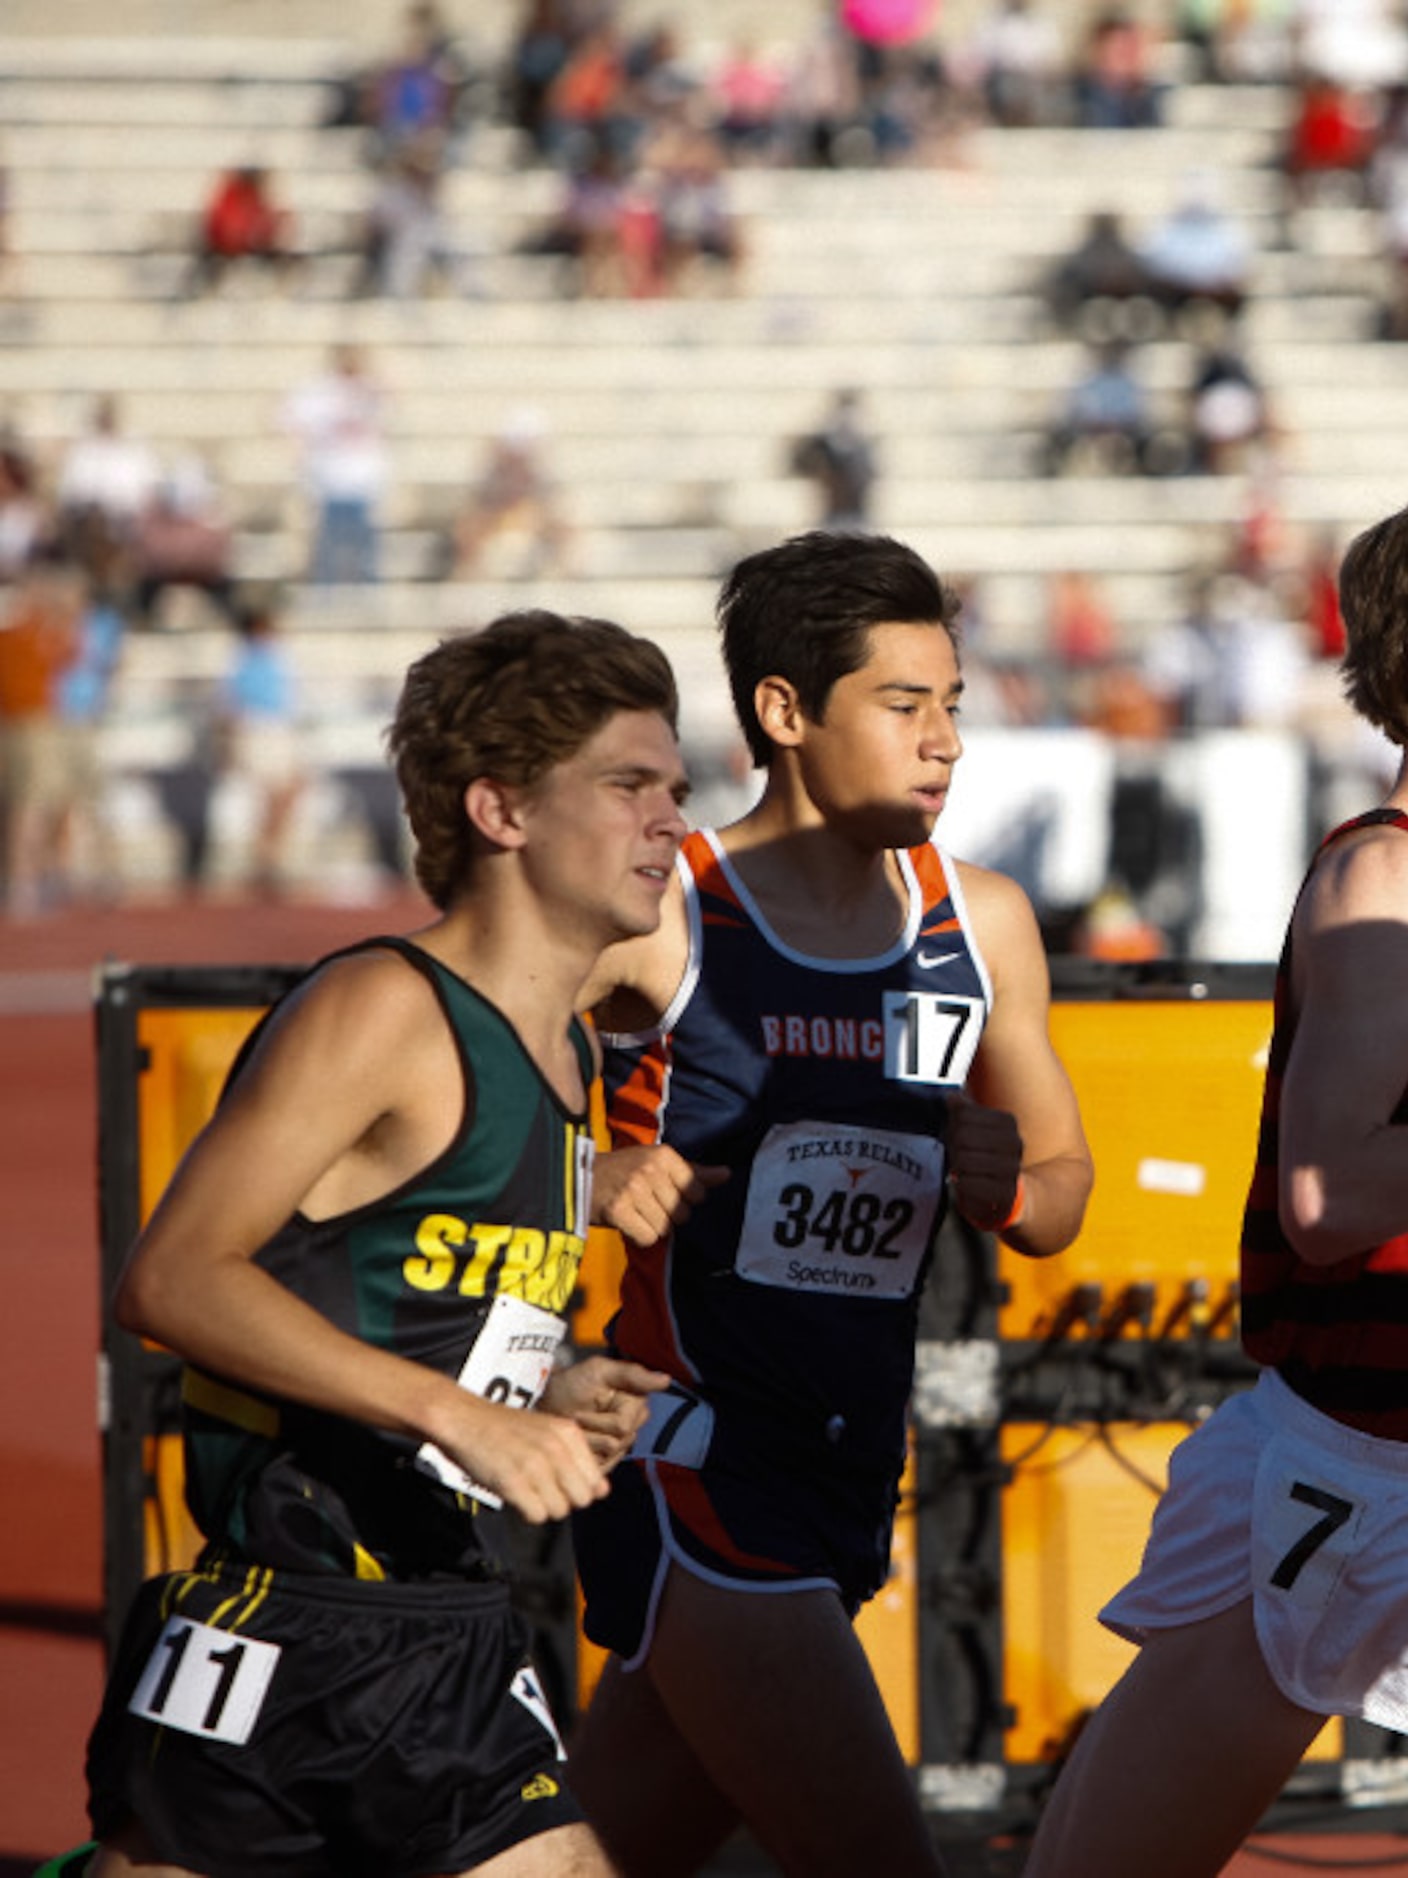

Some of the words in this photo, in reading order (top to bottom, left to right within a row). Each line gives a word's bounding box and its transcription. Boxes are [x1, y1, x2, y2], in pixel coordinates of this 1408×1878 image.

[892, 998, 971, 1079] 17
[787, 1140, 853, 1163] TEXAS
[857, 1141, 923, 1181] RELAYS
[773, 1182, 914, 1260] 3482
[787, 1261, 877, 1289] Spectrum
[1270, 1482, 1353, 1590] 7
[149, 1625, 246, 1731] 11
